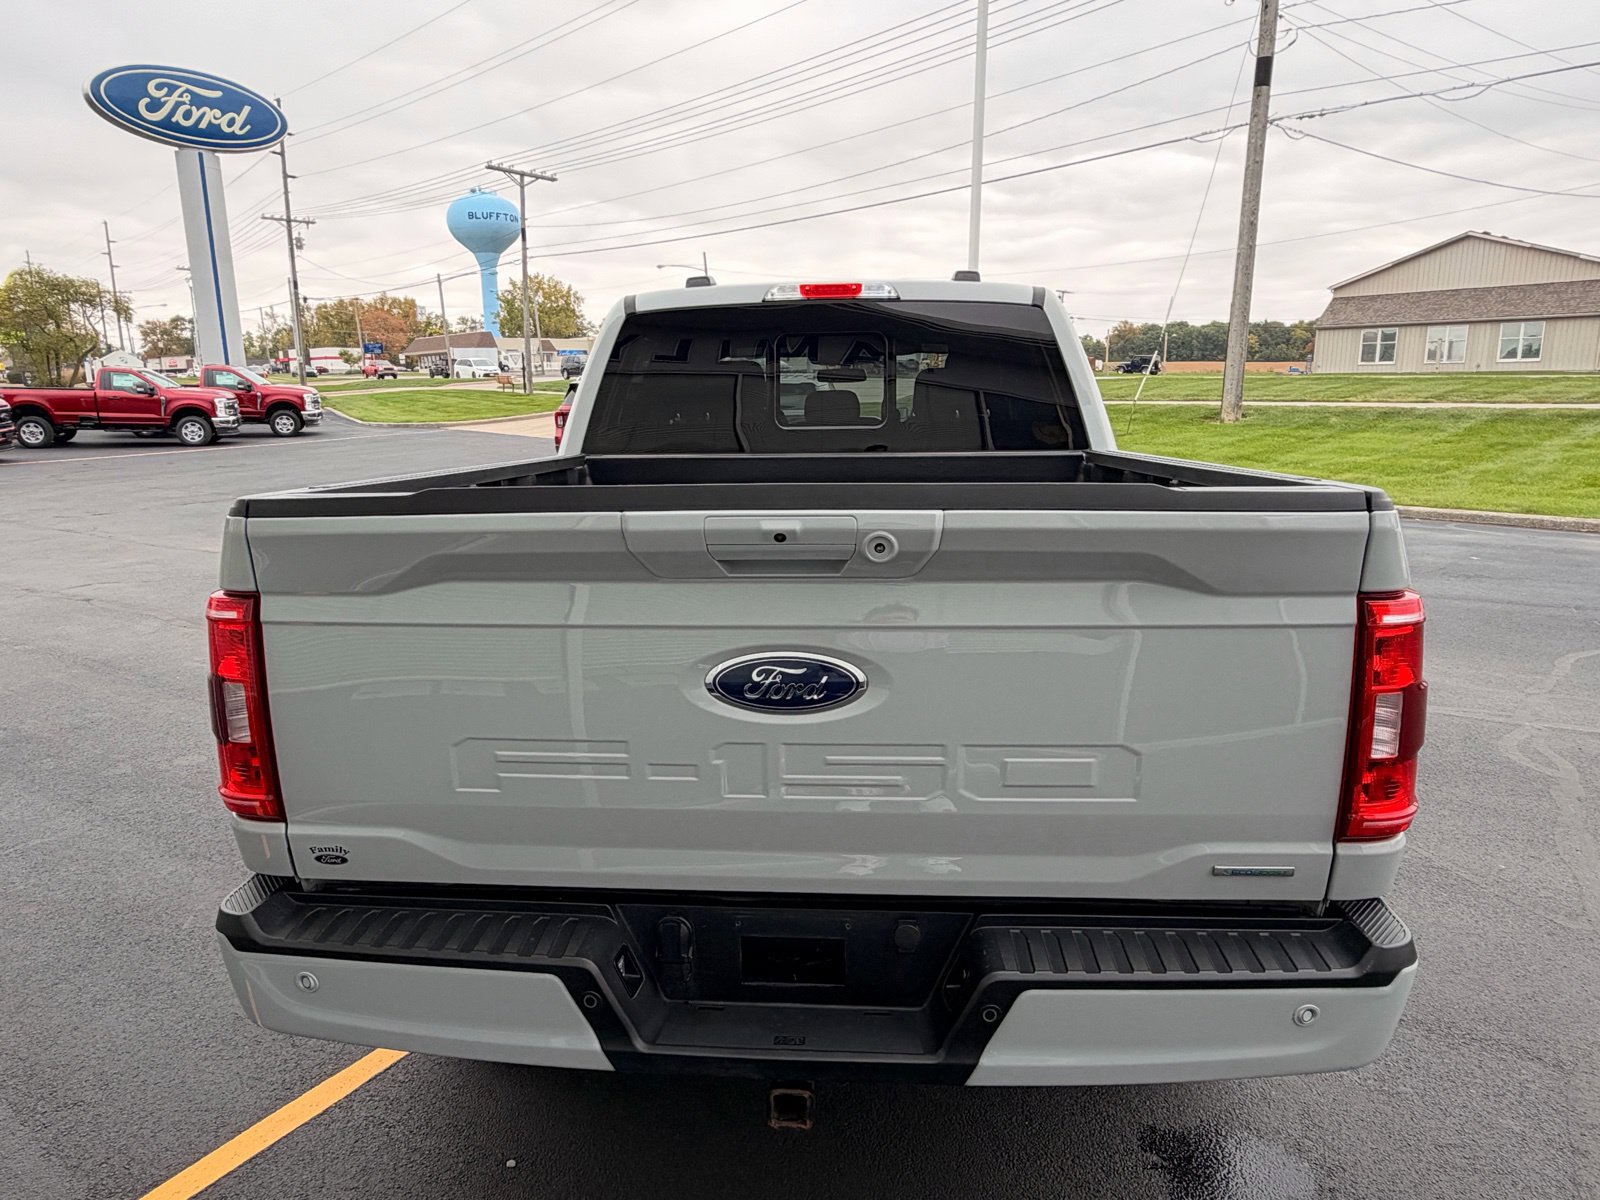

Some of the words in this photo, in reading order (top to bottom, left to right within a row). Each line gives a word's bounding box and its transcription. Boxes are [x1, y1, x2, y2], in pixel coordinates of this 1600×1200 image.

[138, 78, 252, 135] Ford
[467, 211, 519, 224] BLUFFTON
[743, 665, 829, 700] Ford
[450, 737, 1142, 801] F-150
[309, 845, 350, 856] Family
